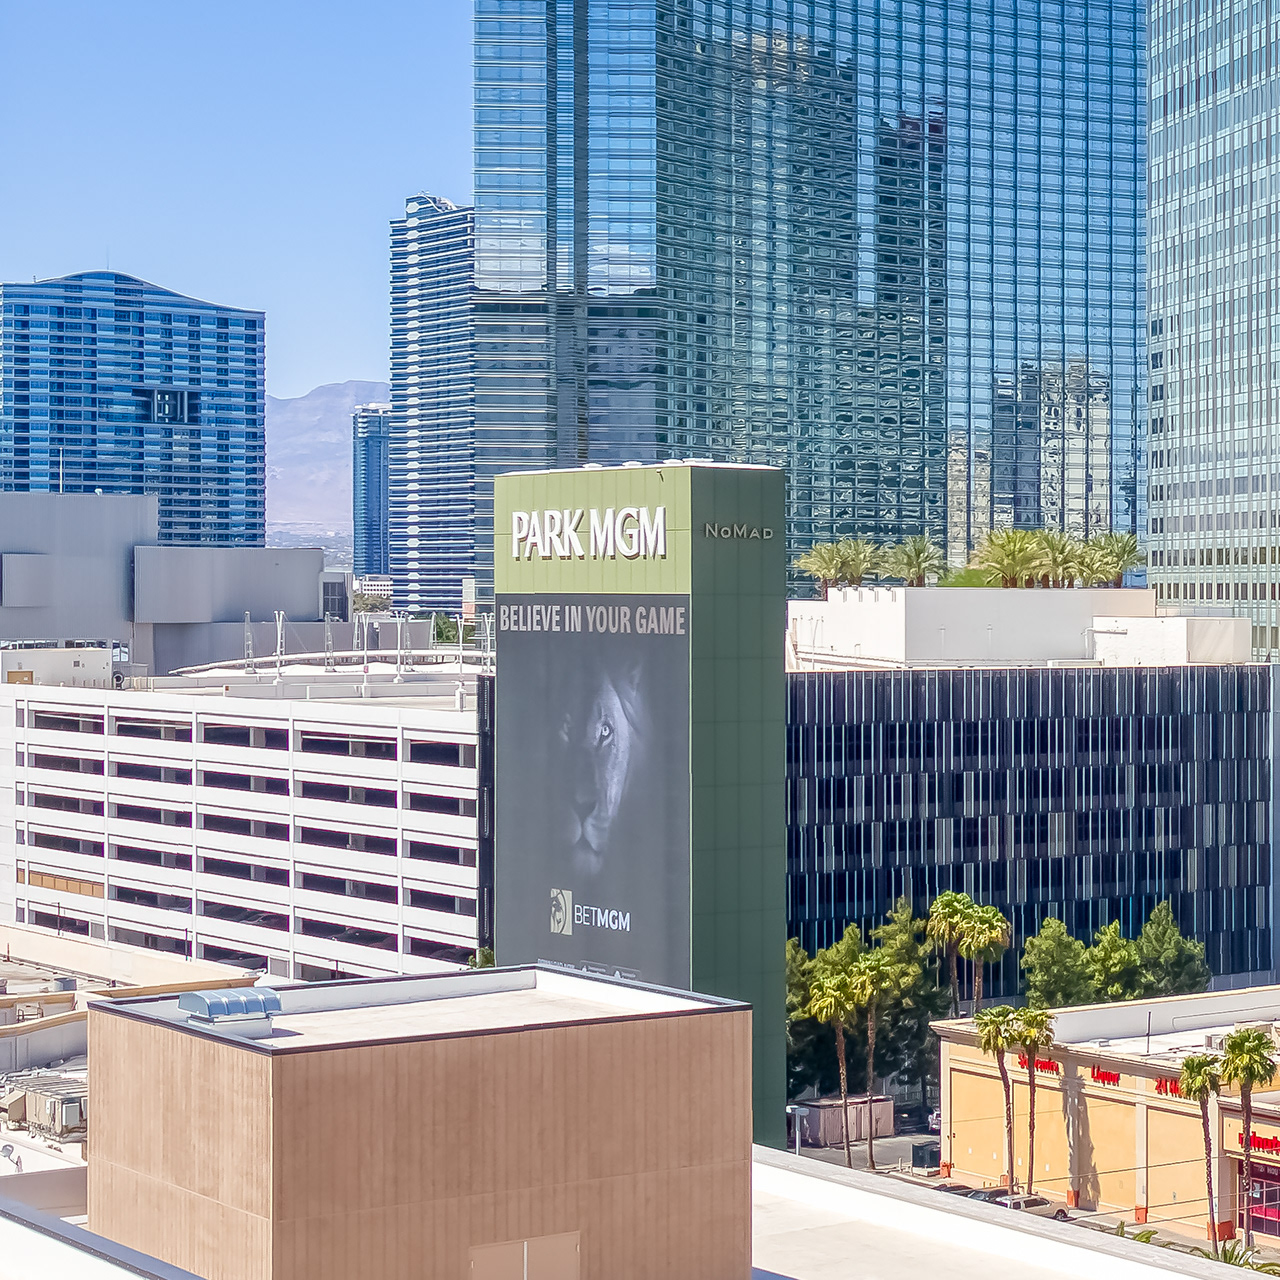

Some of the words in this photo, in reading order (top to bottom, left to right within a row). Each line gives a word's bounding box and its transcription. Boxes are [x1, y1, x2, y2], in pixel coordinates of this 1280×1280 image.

[512, 509, 585, 560] PARK
[589, 506, 667, 560] MGM
[500, 604, 560, 632] BELIEVE
[565, 605, 582, 632] IN
[585, 605, 631, 634] YOUR
[635, 606, 686, 635] GAME
[574, 904, 631, 932] BETMGM
